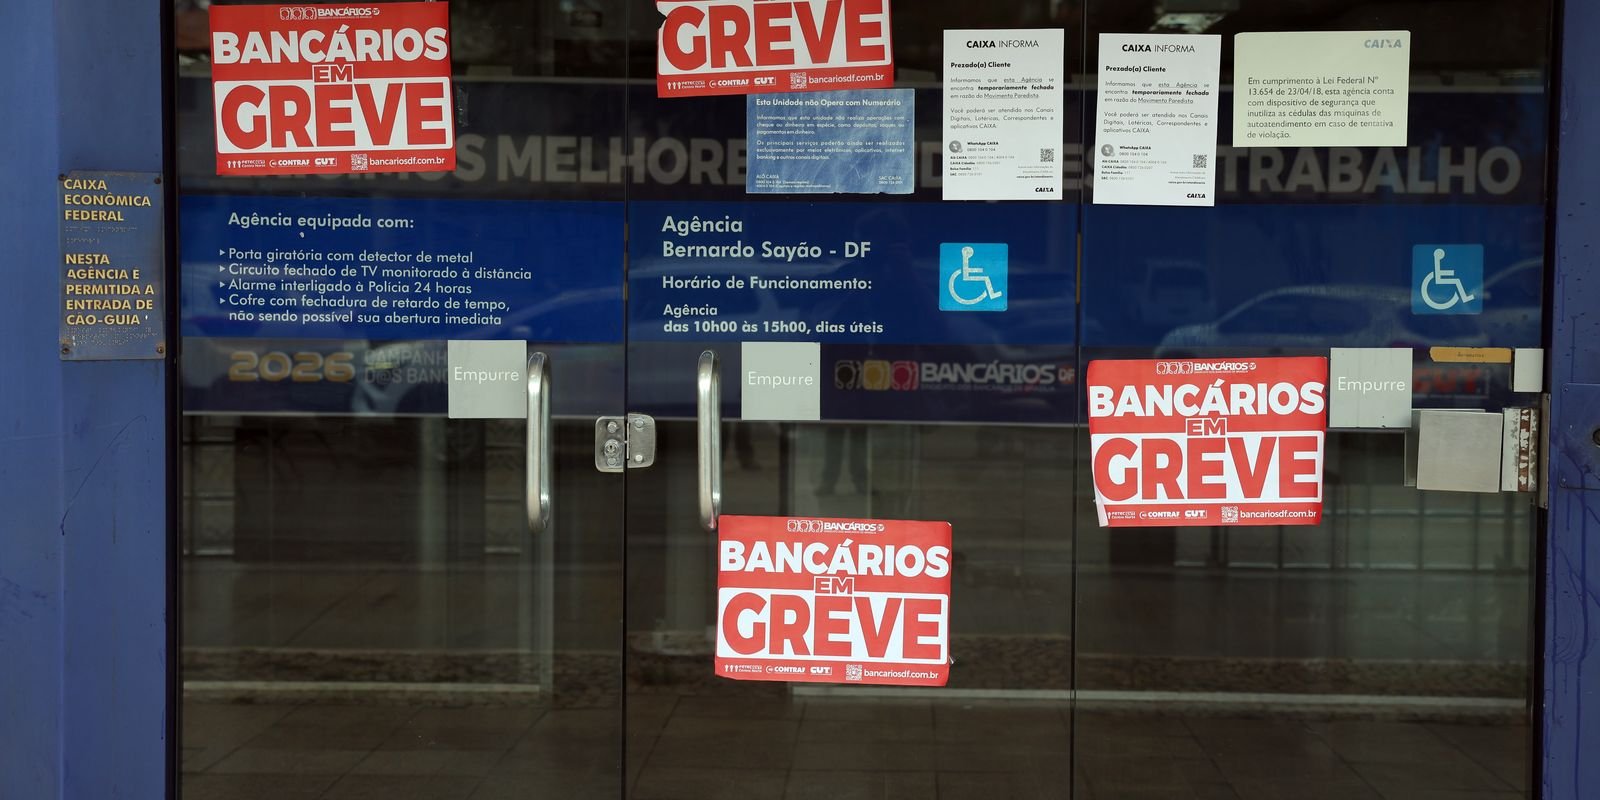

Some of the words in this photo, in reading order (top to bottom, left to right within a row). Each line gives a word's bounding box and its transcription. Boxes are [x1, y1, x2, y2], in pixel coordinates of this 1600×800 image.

[317, 7, 372, 17] BANCÁRIOS
[662, 0, 885, 71] GREVE
[212, 24, 448, 64] BANCÁRIOS
[966, 40, 996, 48] CAIXA
[998, 40, 1040, 48] INFORMA
[1122, 44, 1152, 52] CAIXA
[1154, 45, 1195, 53] INFORMA
[1364, 38, 1402, 49] CAIXA
[312, 64, 354, 83] EM
[1105, 65, 1142, 73] Prezado(a)
[808, 73, 885, 84] bancariosdf.com.br
[1248, 77, 1260, 85] Em
[1262, 77, 1314, 87] cumprimento
[1336, 76, 1365, 84] Federal
[1248, 88, 1273, 96] 13.654
[1275, 88, 1286, 96] de
[1287, 87, 1323, 96] 23/04/18,
[1342, 87, 1371, 97] agência
[772, 98, 803, 106] Unidade
[820, 99, 844, 108] Opera
[862, 98, 901, 106] Numerário
[1266, 99, 1307, 108] dispositivo
[1321, 99, 1359, 108] segurança
[1361, 99, 1376, 107] que
[221, 82, 447, 150] GREVE
[1247, 109, 1276, 117] inutiliza
[1288, 109, 1316, 117] cédulas
[1319, 109, 1332, 117] das
[1371, 109, 1381, 117] de
[1247, 120, 1312, 128] autoatendimento
[1258, 131, 1291, 140] violação.
[314, 157, 335, 165] CUT
[369, 156, 446, 166] bancariosdf.com.br
[497, 135, 747, 185] MELHORE
[64, 179, 107, 190] CAIXA
[64, 192, 152, 207] ECONÔMICA
[64, 210, 124, 221] FEDERAL
[228, 211, 292, 228] Agência
[297, 213, 372, 230] equipada
[376, 217, 415, 229] com:
[661, 215, 743, 236] Agência
[228, 248, 262, 260] Porta
[266, 249, 323, 263] giratória
[327, 251, 355, 261] com
[358, 250, 411, 263] detector
[416, 251, 433, 263] de
[436, 251, 473, 263] metal
[662, 240, 755, 258] Bernardo
[761, 241, 822, 262] Sayão
[844, 242, 871, 258] DF
[66, 254, 110, 265] NESTA
[67, 266, 129, 280] AGÊNCIA
[228, 263, 280, 276] Circuito
[283, 264, 336, 277] fechado
[340, 265, 357, 277] de
[361, 266, 378, 277] TV
[382, 266, 458, 279] monitorado
[461, 266, 470, 279] à
[474, 267, 532, 280] distância
[66, 284, 141, 295] PERMITIDA
[145, 285, 154, 295] A
[228, 279, 277, 291] Alarme
[280, 280, 352, 295] interligado
[356, 280, 364, 292] à
[368, 280, 410, 293] Polícia
[414, 282, 431, 293] 24
[435, 282, 472, 294] horas
[662, 275, 721, 289] Horário
[725, 276, 744, 289] de
[750, 276, 872, 290] Funcionamento:
[66, 299, 132, 310] ENTRADA
[136, 299, 153, 310] DE
[228, 294, 266, 307] Cofre
[269, 298, 297, 307] com
[301, 296, 367, 308] fechadura
[371, 296, 388, 309] de
[392, 297, 440, 310] retardo
[443, 298, 461, 310] de
[464, 299, 511, 313] tempo,
[229, 311, 255, 322] não
[258, 310, 298, 322] sendo
[302, 310, 354, 325] possível
[357, 314, 380, 323] sua
[384, 312, 441, 324] abertura
[445, 313, 502, 325] imediata
[663, 304, 718, 318] Agência
[66, 313, 141, 325] CÃO-GUIA
[663, 321, 689, 333] das
[694, 320, 737, 333] 10h00
[742, 321, 758, 333] às
[763, 321, 811, 335] 15h00,
[815, 321, 846, 333] dias
[849, 322, 884, 333] úteis
[228, 351, 355, 382] 2026
[920, 359, 1056, 385] BANCÁRIOS
[1194, 361, 1249, 371] BANCÁRIOS
[407, 367, 449, 384] BANC
[454, 366, 520, 385] Empurre
[748, 371, 814, 389] Empurre
[1338, 376, 1406, 395] Empurre
[1089, 378, 1325, 418] BANCÁRIOS
[1185, 417, 1228, 436] EM
[1093, 435, 1318, 502] GREVE
[1184, 510, 1205, 518] CUT
[1240, 508, 1317, 519] bancariosdf.com.br
[823, 521, 877, 532] BANCÁRIOS
[720, 538, 950, 578] BANCÁRIOS
[814, 576, 855, 595] EM
[722, 592, 942, 660] GREVE
[863, 669, 939, 680] bancariosdf.com.br
